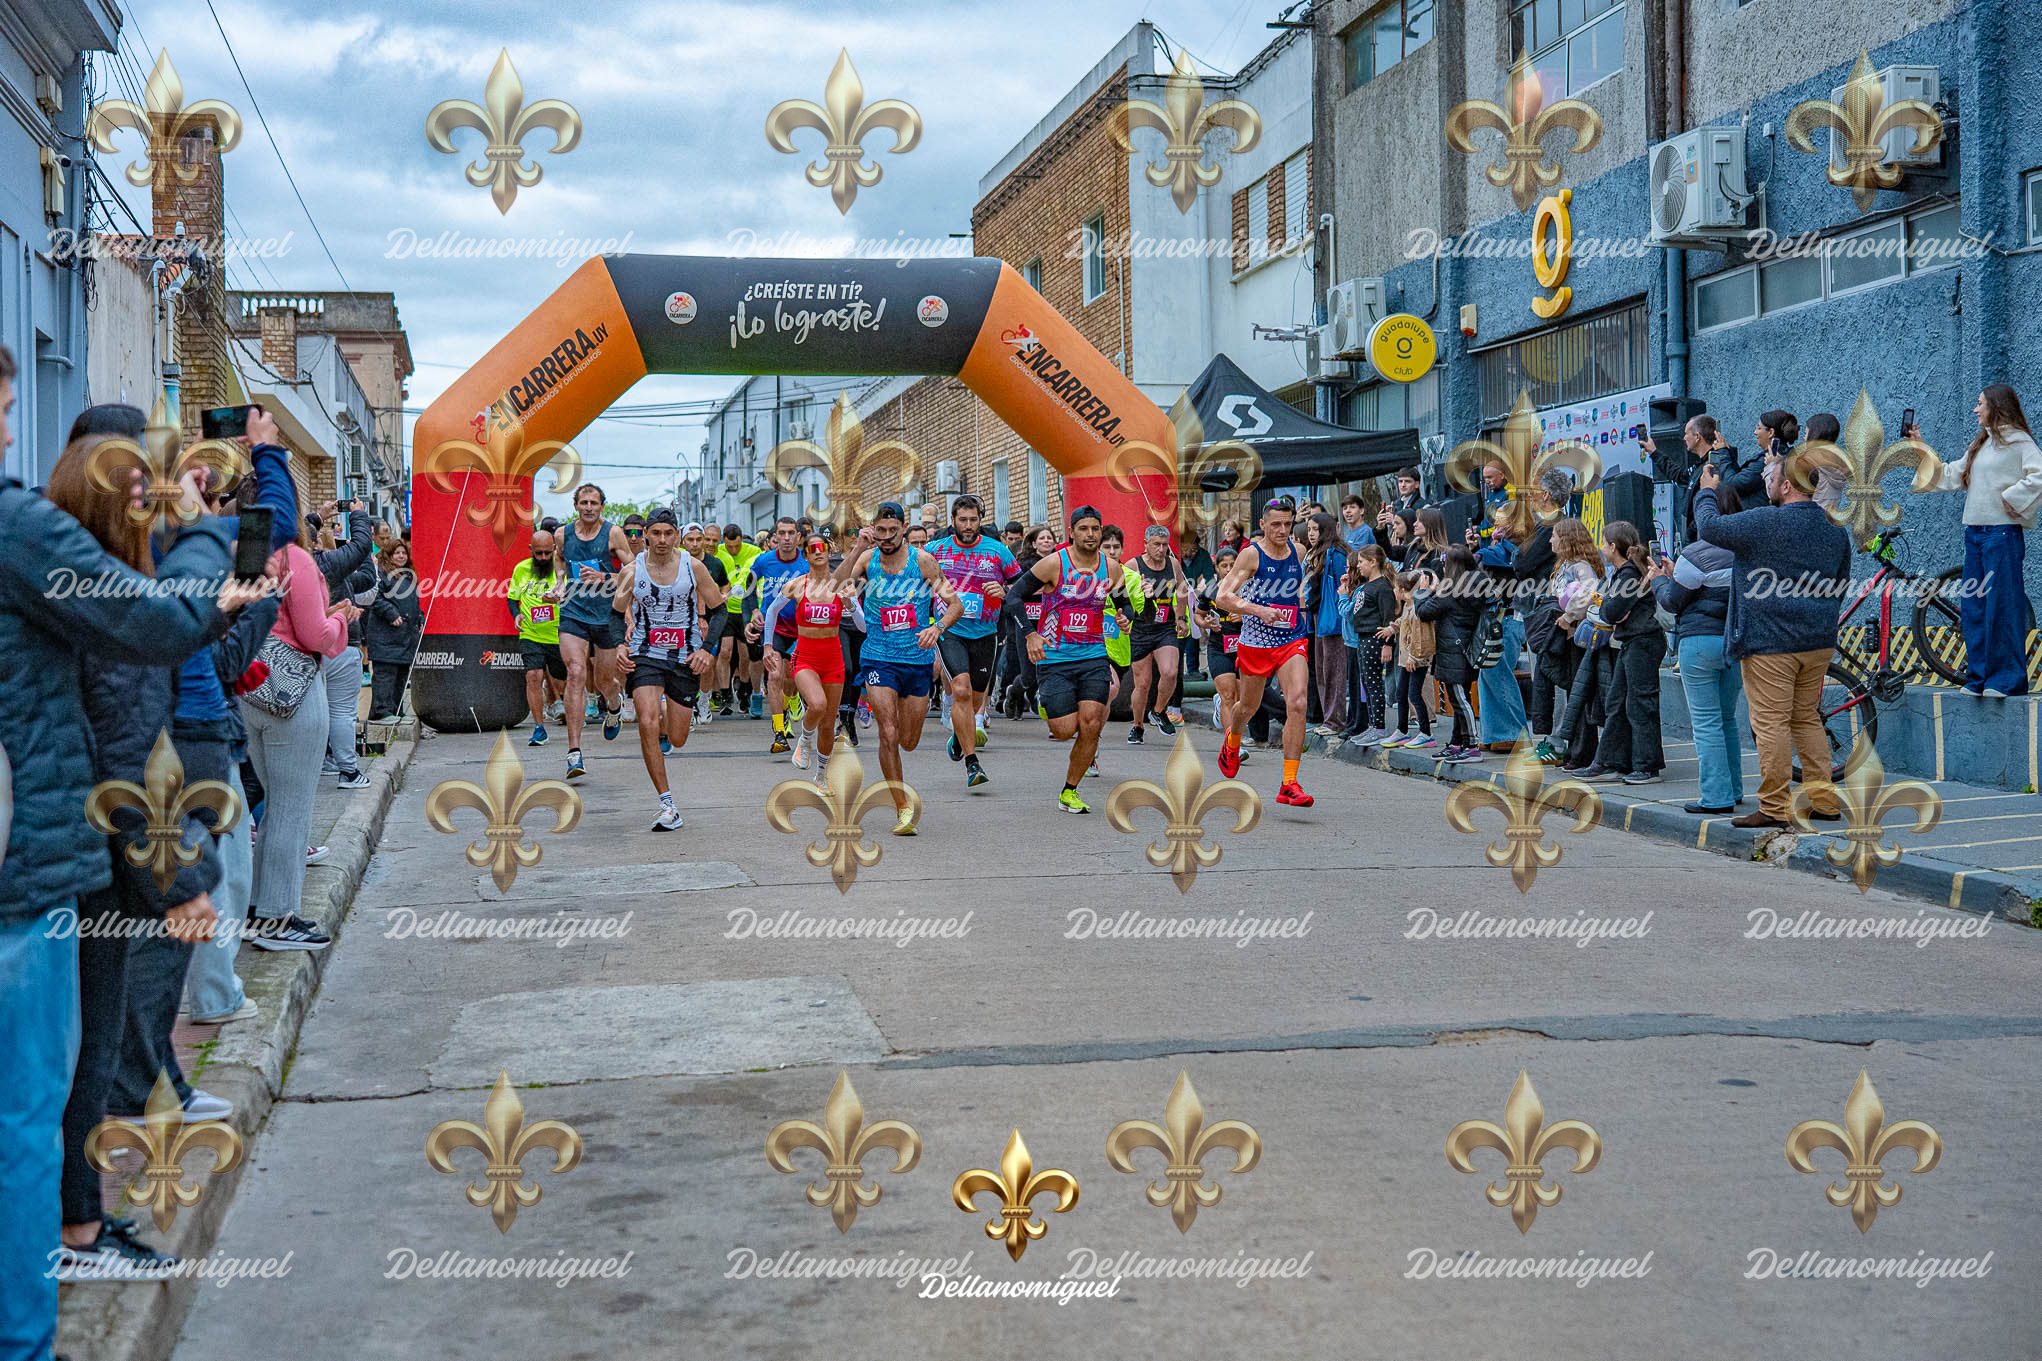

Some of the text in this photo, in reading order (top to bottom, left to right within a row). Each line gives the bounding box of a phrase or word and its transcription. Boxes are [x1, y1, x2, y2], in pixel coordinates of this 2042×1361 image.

[744, 280, 863, 301] ¿CREÍSTE EN TÍ?
[774, 297, 887, 345] lograste!
[1380, 320, 1430, 343] guadalupe
[1394, 367, 1413, 375] club
[503, 387, 559, 437] CRONOMETRAMOS
[563, 349, 602, 386] DIFUNDIMOS
[533, 607, 551, 619] 245
[811, 606, 830, 618] 178
[886, 609, 908, 624] 179
[1026, 605, 1042, 615] 205
[1069, 612, 1088, 626] 199
[654, 632, 679, 644] 234
